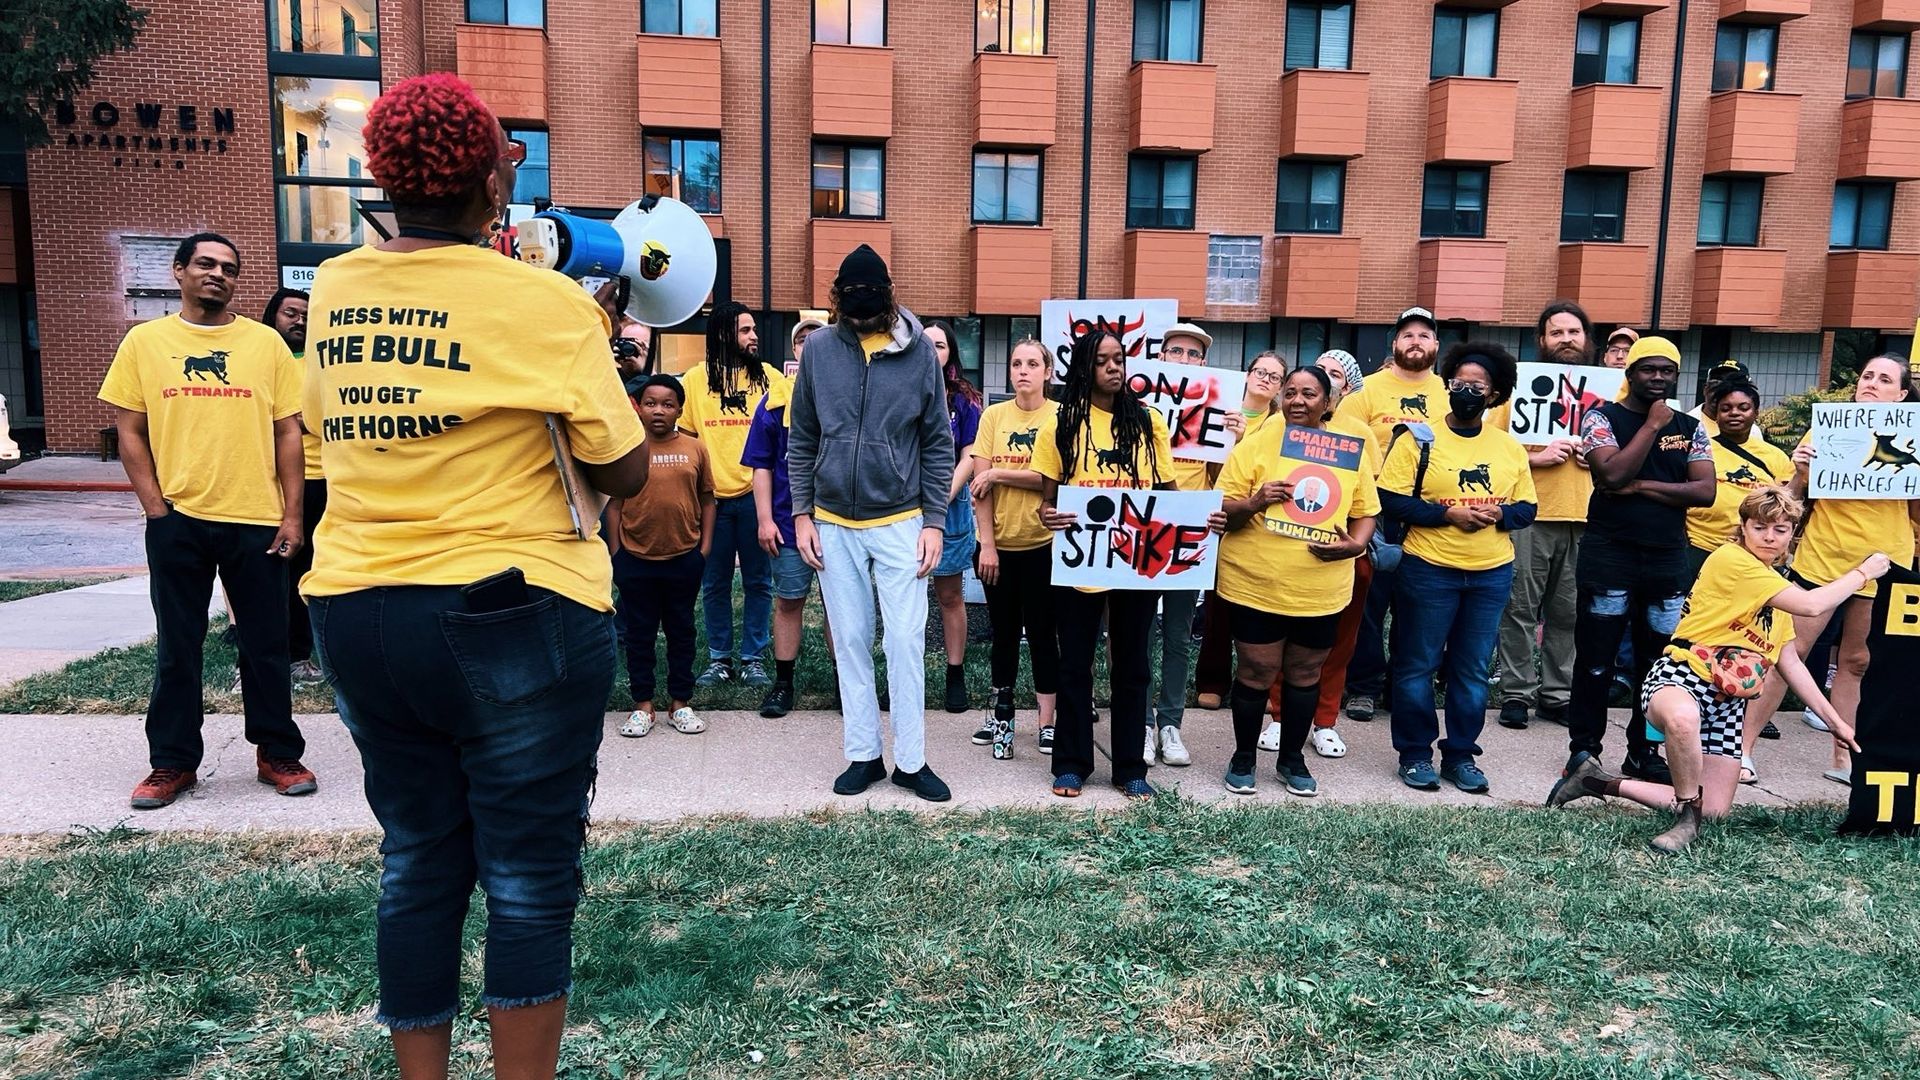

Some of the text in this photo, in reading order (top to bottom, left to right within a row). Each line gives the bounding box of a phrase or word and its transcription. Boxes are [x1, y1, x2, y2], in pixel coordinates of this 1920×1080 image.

[56, 99, 235, 132] BOWEN
[66, 133, 227, 153] APARTMENTS
[292, 270, 315, 281] 816
[329, 307, 449, 329] MESS WITH
[316, 335, 471, 372] THE BULL
[163, 387, 252, 399] KC TENANTS
[339, 386, 422, 405] YOU GET
[1127, 372, 1189, 405] ON
[1531, 373, 1587, 401] ON
[719, 418, 752, 426] TENAN
[1512, 397, 1601, 436] STRIK
[1816, 408, 1916, 429] WHERE ARE
[324, 416, 355, 442] THE
[1289, 429, 1360, 453] CHARLES
[652, 454, 689, 464] ANGELES
[1304, 444, 1338, 462] HILL
[1079, 480, 1094, 488] KC
[1817, 469, 1917, 495] CHARLES H
[1086, 493, 1157, 526] ON
[1440, 498, 1456, 506] KC
[1266, 520, 1341, 544] SLUMLORD
[1061, 522, 1208, 571] STRIKE
[1884, 582, 1920, 636] B
